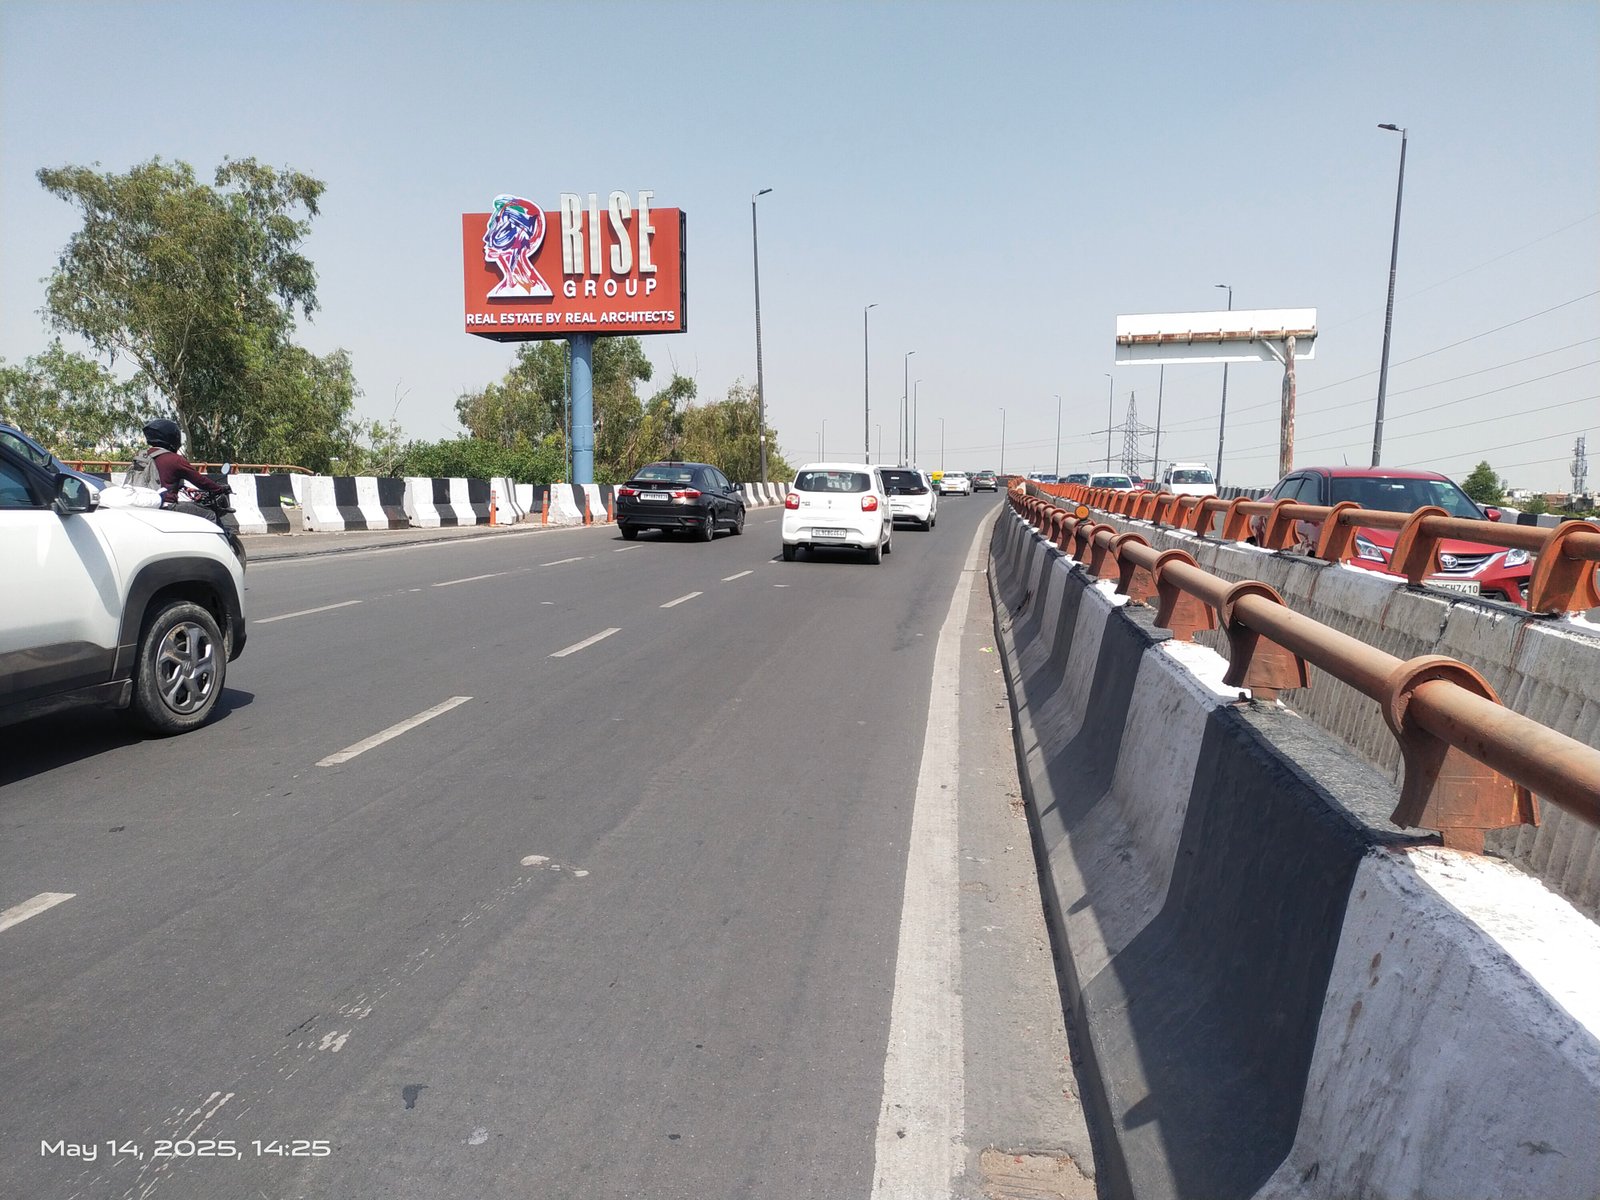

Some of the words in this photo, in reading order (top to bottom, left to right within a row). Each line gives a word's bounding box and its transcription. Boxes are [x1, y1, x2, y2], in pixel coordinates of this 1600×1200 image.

[560, 190, 657, 275] RISE
[563, 278, 657, 298] GROUP
[466, 313, 497, 325] REAL
[500, 313, 543, 325] ESTATE
[546, 312, 562, 324] BY
[565, 312, 597, 324] REAL
[600, 310, 675, 323] ARCHITECTS
